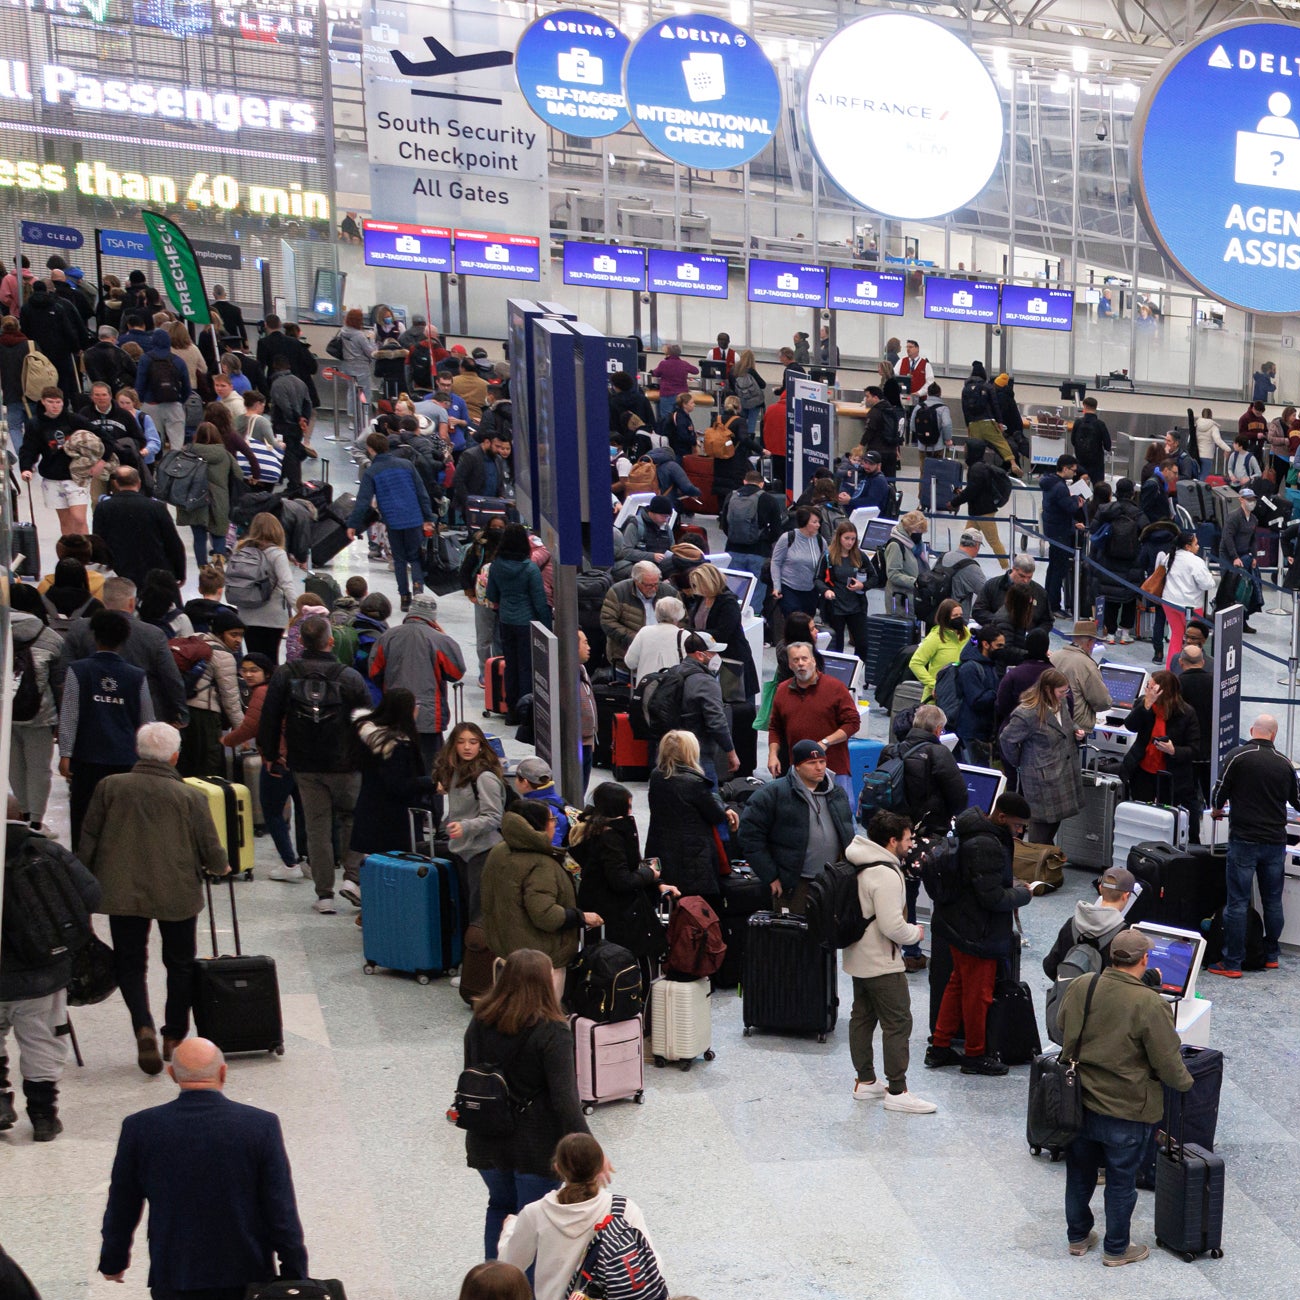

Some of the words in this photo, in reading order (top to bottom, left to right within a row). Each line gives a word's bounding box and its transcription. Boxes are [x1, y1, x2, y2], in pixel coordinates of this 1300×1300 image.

[219, 9, 313, 38] CLEAR
[558, 21, 602, 36] DELTA
[676, 26, 730, 45] DELTA
[42, 65, 317, 133] Passengers
[535, 85, 626, 108] SELF-TAGGED
[547, 101, 577, 117] BAG
[579, 105, 618, 121] DROP
[636, 104, 772, 134] INTERNATIONAL
[378, 112, 440, 136] South
[447, 119, 536, 150] Security
[664, 125, 744, 149] CHECK-IN
[399, 142, 518, 171] Checkpoint
[76, 161, 177, 204] than
[188, 172, 240, 210] 40
[250, 182, 330, 219] min
[412, 178, 442, 198] All
[449, 182, 509, 204] Gates
[46, 232, 78, 243] CLEAR
[105, 237, 125, 250] TSA
[127, 238, 144, 251] Pre
[195, 250, 233, 262] mployees
[370, 251, 412, 262] SELF-TAGGED
[429, 257, 446, 265] DROP
[460, 260, 501, 272] SELF-TAGGED
[517, 266, 534, 274] DROP
[569, 271, 607, 281] SELF-TAGGED
[623, 276, 640, 284] DROP
[653, 278, 691, 289] SELF-TAGGED
[754, 288, 790, 299] SELF-TAGGED
[806, 293, 821, 301] DROP
[833, 296, 870, 307] SELF-TAGGED
[884, 301, 899, 309] DROP
[930, 305, 965, 315] SELF-TAGGED
[979, 310, 994, 318] DROP
[1005, 313, 1039, 323] SELF-TAGGED
[1053, 317, 1068, 325] DROP
[93, 694, 125, 705] CLEAR
